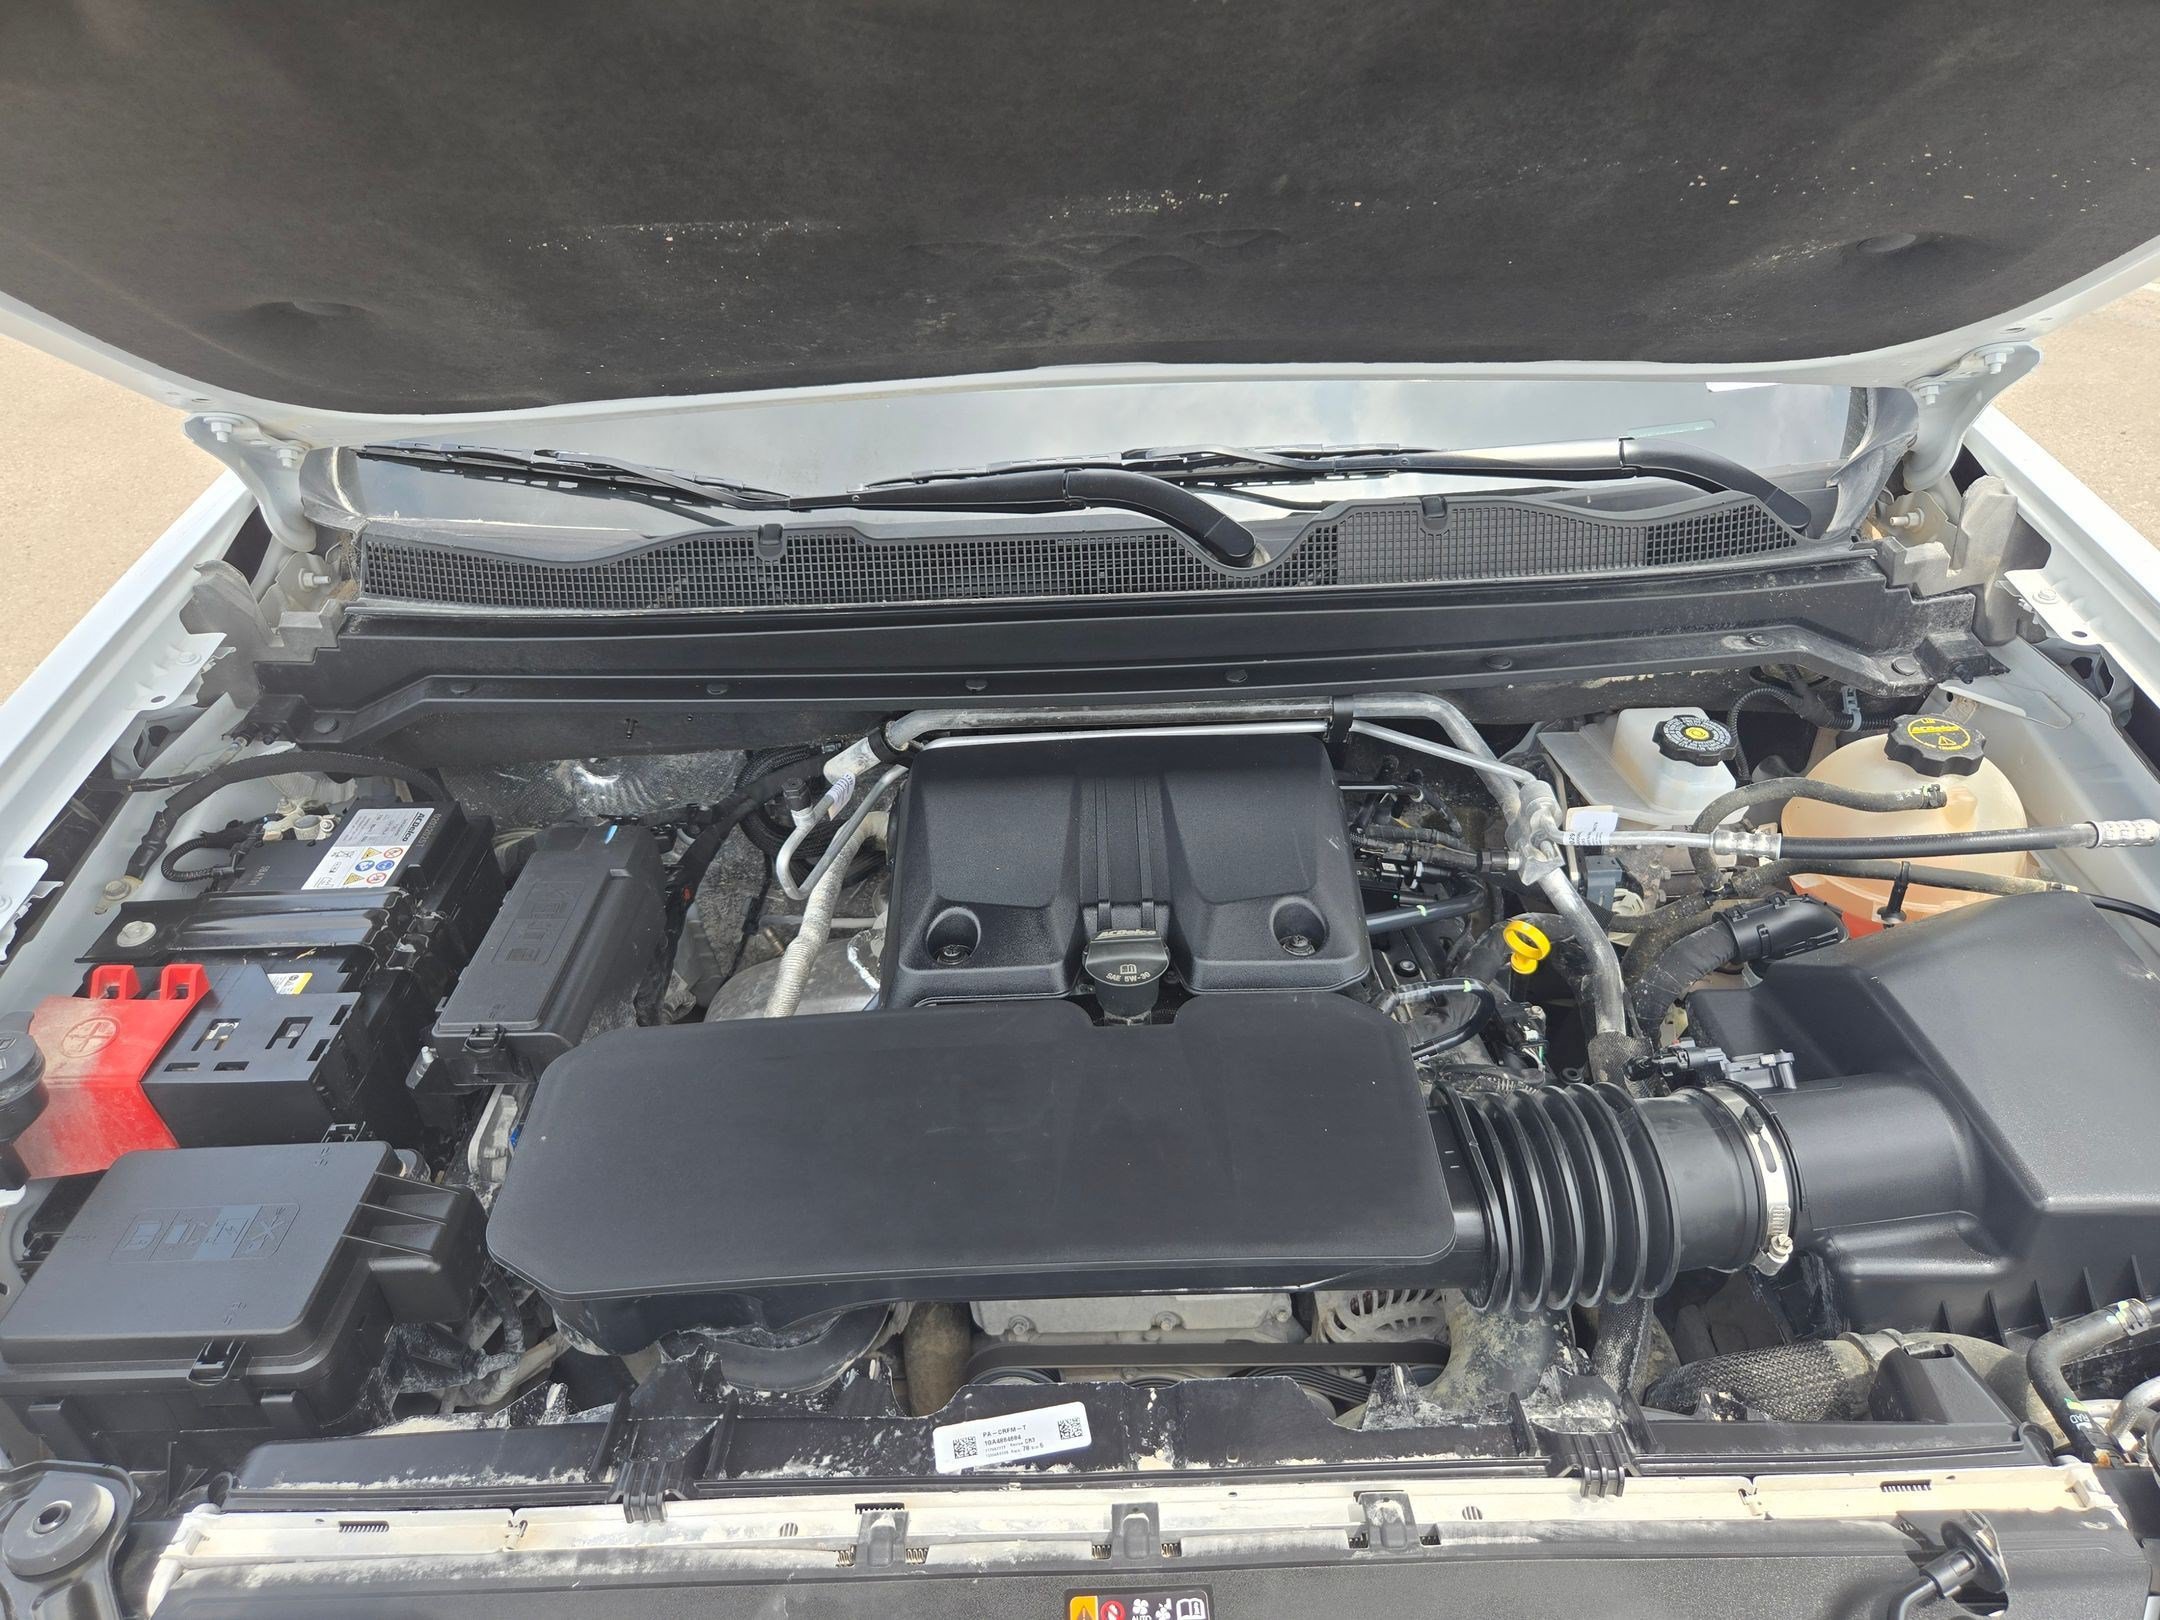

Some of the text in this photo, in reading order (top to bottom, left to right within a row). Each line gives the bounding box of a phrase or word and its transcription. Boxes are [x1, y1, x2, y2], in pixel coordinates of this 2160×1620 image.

[402, 812, 426, 842] ACDelco
[1095, 929, 1157, 939] ACDelco
[1105, 971, 1151, 982] SAE 5W-30
[2069, 1413, 2091, 1424] RAD
